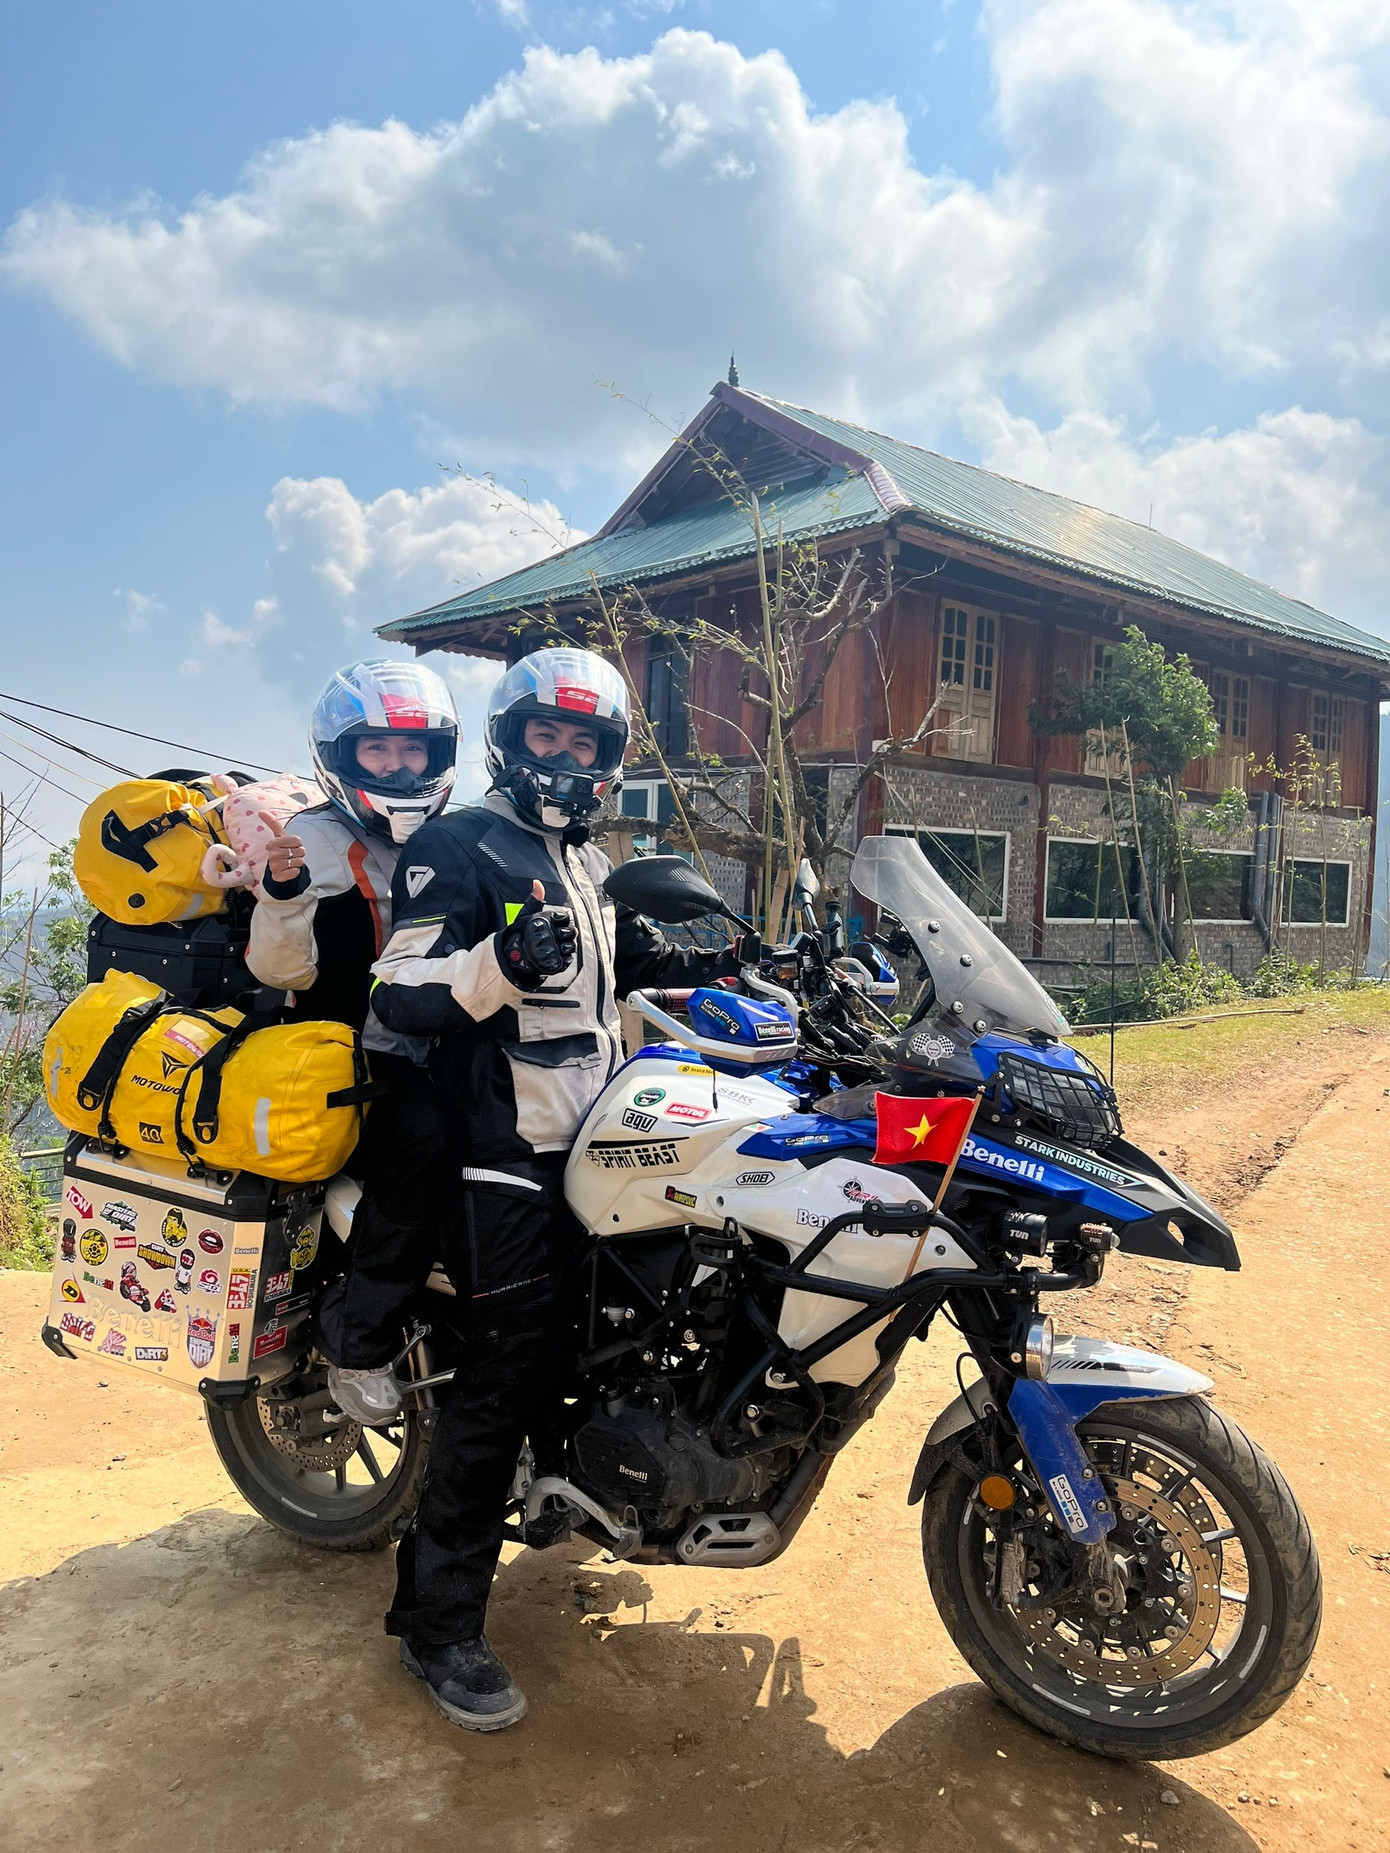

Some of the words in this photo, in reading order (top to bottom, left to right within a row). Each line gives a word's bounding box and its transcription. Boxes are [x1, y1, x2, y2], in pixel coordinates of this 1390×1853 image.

[703, 998, 740, 1030] GoPro
[668, 1105, 706, 1118] MOTUL
[140, 1126, 161, 1141] 40
[785, 1135, 829, 1143] GoPro
[600, 1148, 636, 1169] SPIRIT
[634, 1143, 680, 1167] BEAST
[961, 1137, 1045, 1182] Benelli
[1015, 1135, 1054, 1158] STARK
[1055, 1150, 1125, 1186] INDUSTRIES
[741, 1173, 769, 1183] SHOEI
[66, 1189, 91, 1213] TOW
[138, 1247, 176, 1268] SHOWDOWN
[83, 1271, 114, 1291] Benelli
[246, 1269, 258, 1309] YOSHIMURA
[86, 1294, 181, 1349] Benelli
[188, 1326, 201, 1337] Red
[202, 1330, 216, 1341] Bull
[228, 1323, 240, 1364] Benelli
[619, 1464, 648, 1481] Benelli
[1057, 1476, 1085, 1528] GoPro
